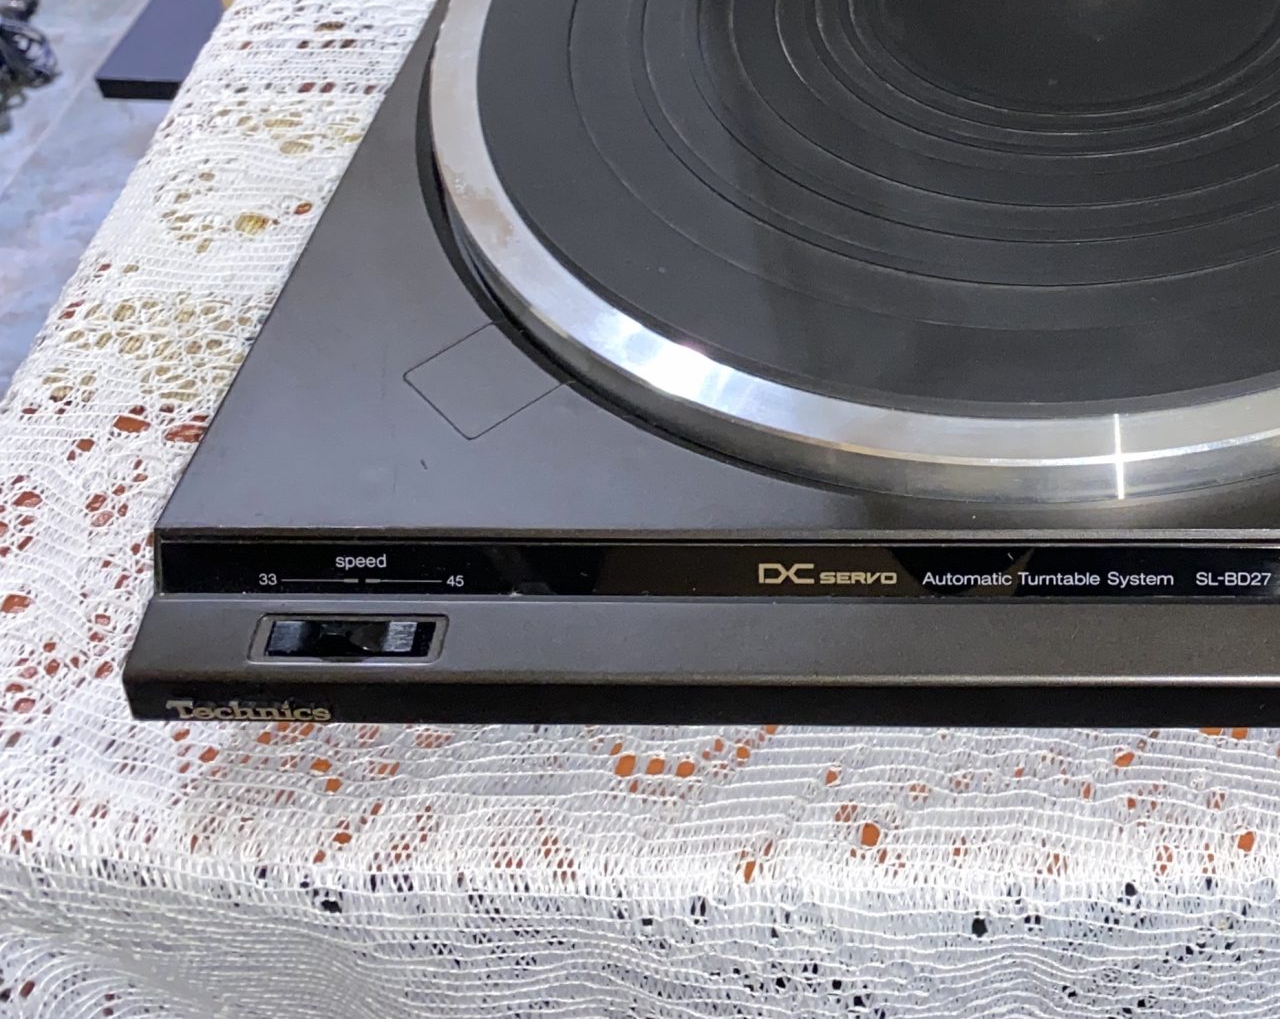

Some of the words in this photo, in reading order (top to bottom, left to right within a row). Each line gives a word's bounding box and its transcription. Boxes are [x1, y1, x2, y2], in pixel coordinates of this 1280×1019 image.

[335, 553, 387, 572] speed
[258, 573, 278, 586] 33
[446, 575, 465, 588] 45
[758, 563, 815, 584] DC
[819, 572, 898, 585] SERVO
[922, 571, 1013, 586] Automatic
[1018, 571, 1101, 586] Turntable
[1107, 571, 1175, 589] System
[1195, 571, 1272, 586] SL-BD27
[165, 698, 331, 720] Technics
